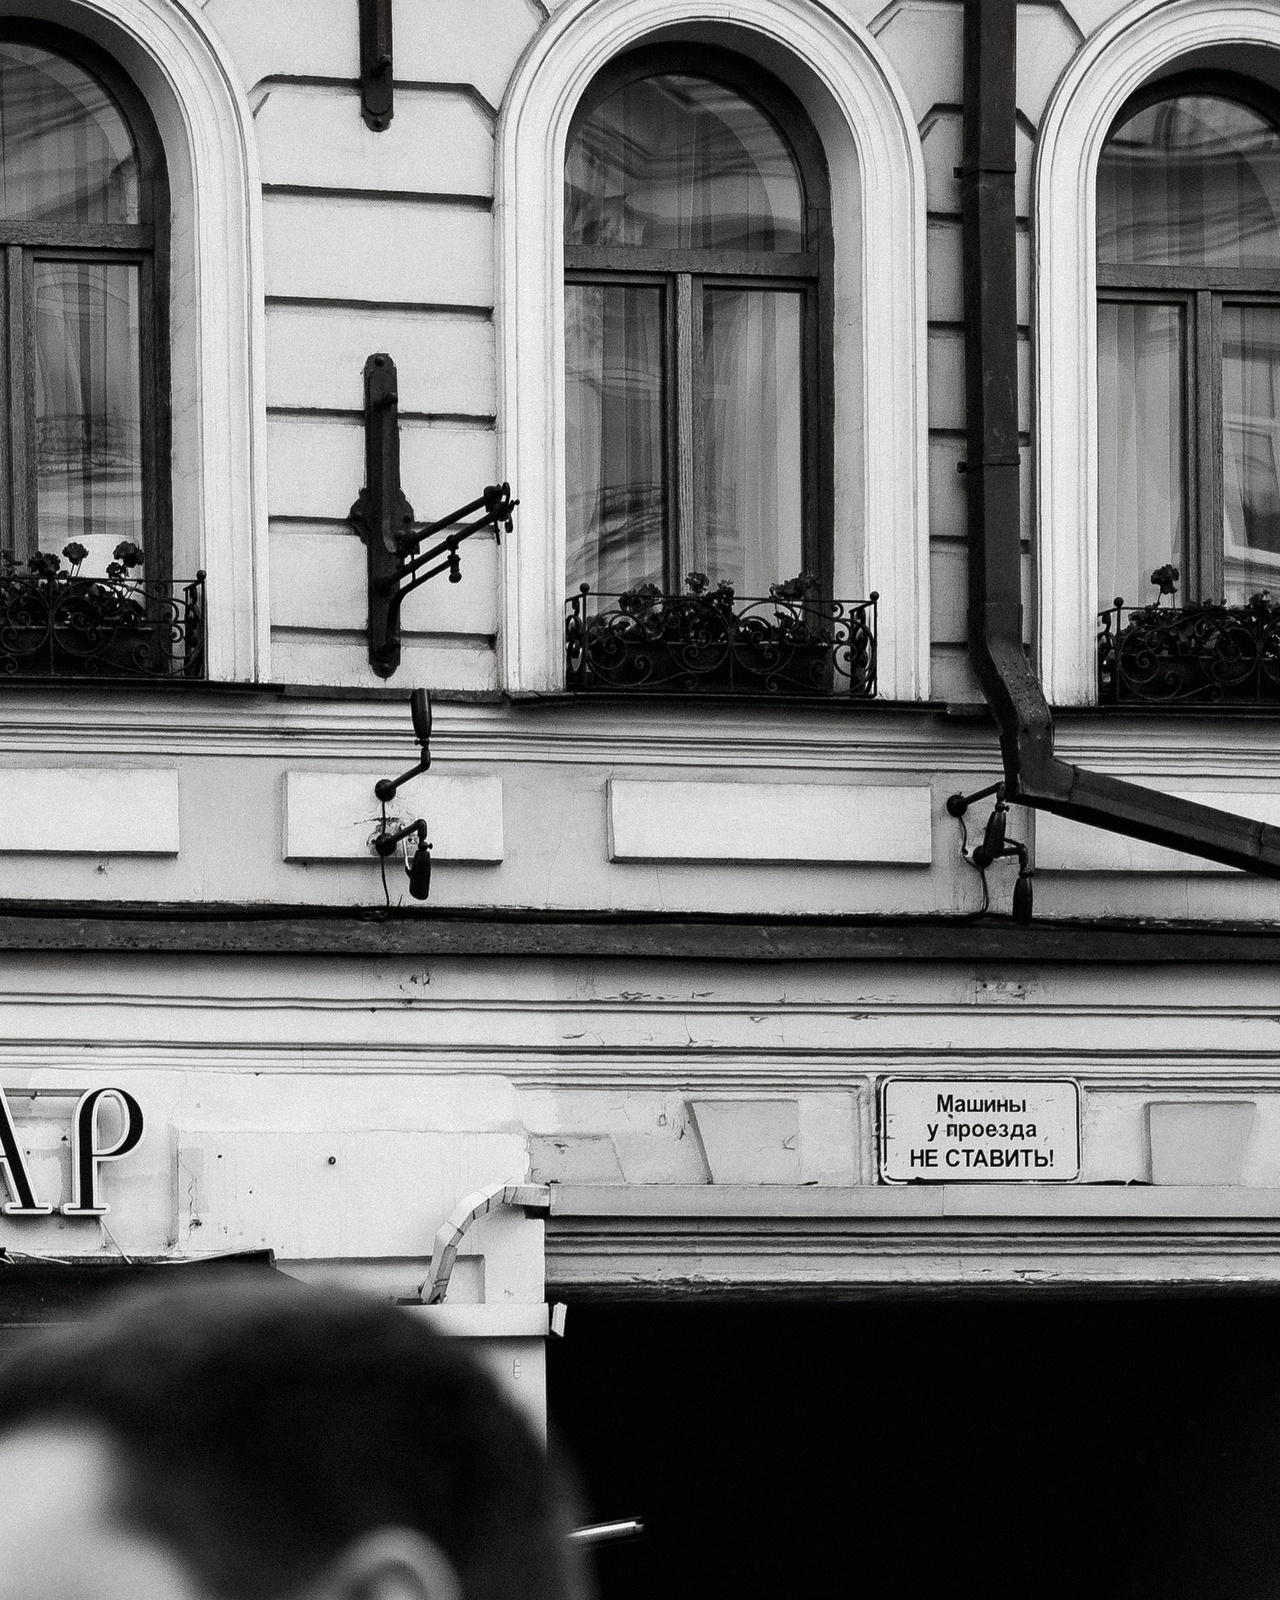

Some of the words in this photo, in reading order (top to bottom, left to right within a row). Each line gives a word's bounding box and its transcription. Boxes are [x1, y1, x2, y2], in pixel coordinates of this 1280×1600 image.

[936, 1093, 1027, 1113] Машины
[927, 1123, 939, 1141] у
[946, 1123, 1037, 1142] проезда
[910, 1149, 938, 1168] НЕ
[945, 1148, 1055, 1168] СТАВИТЬ!
